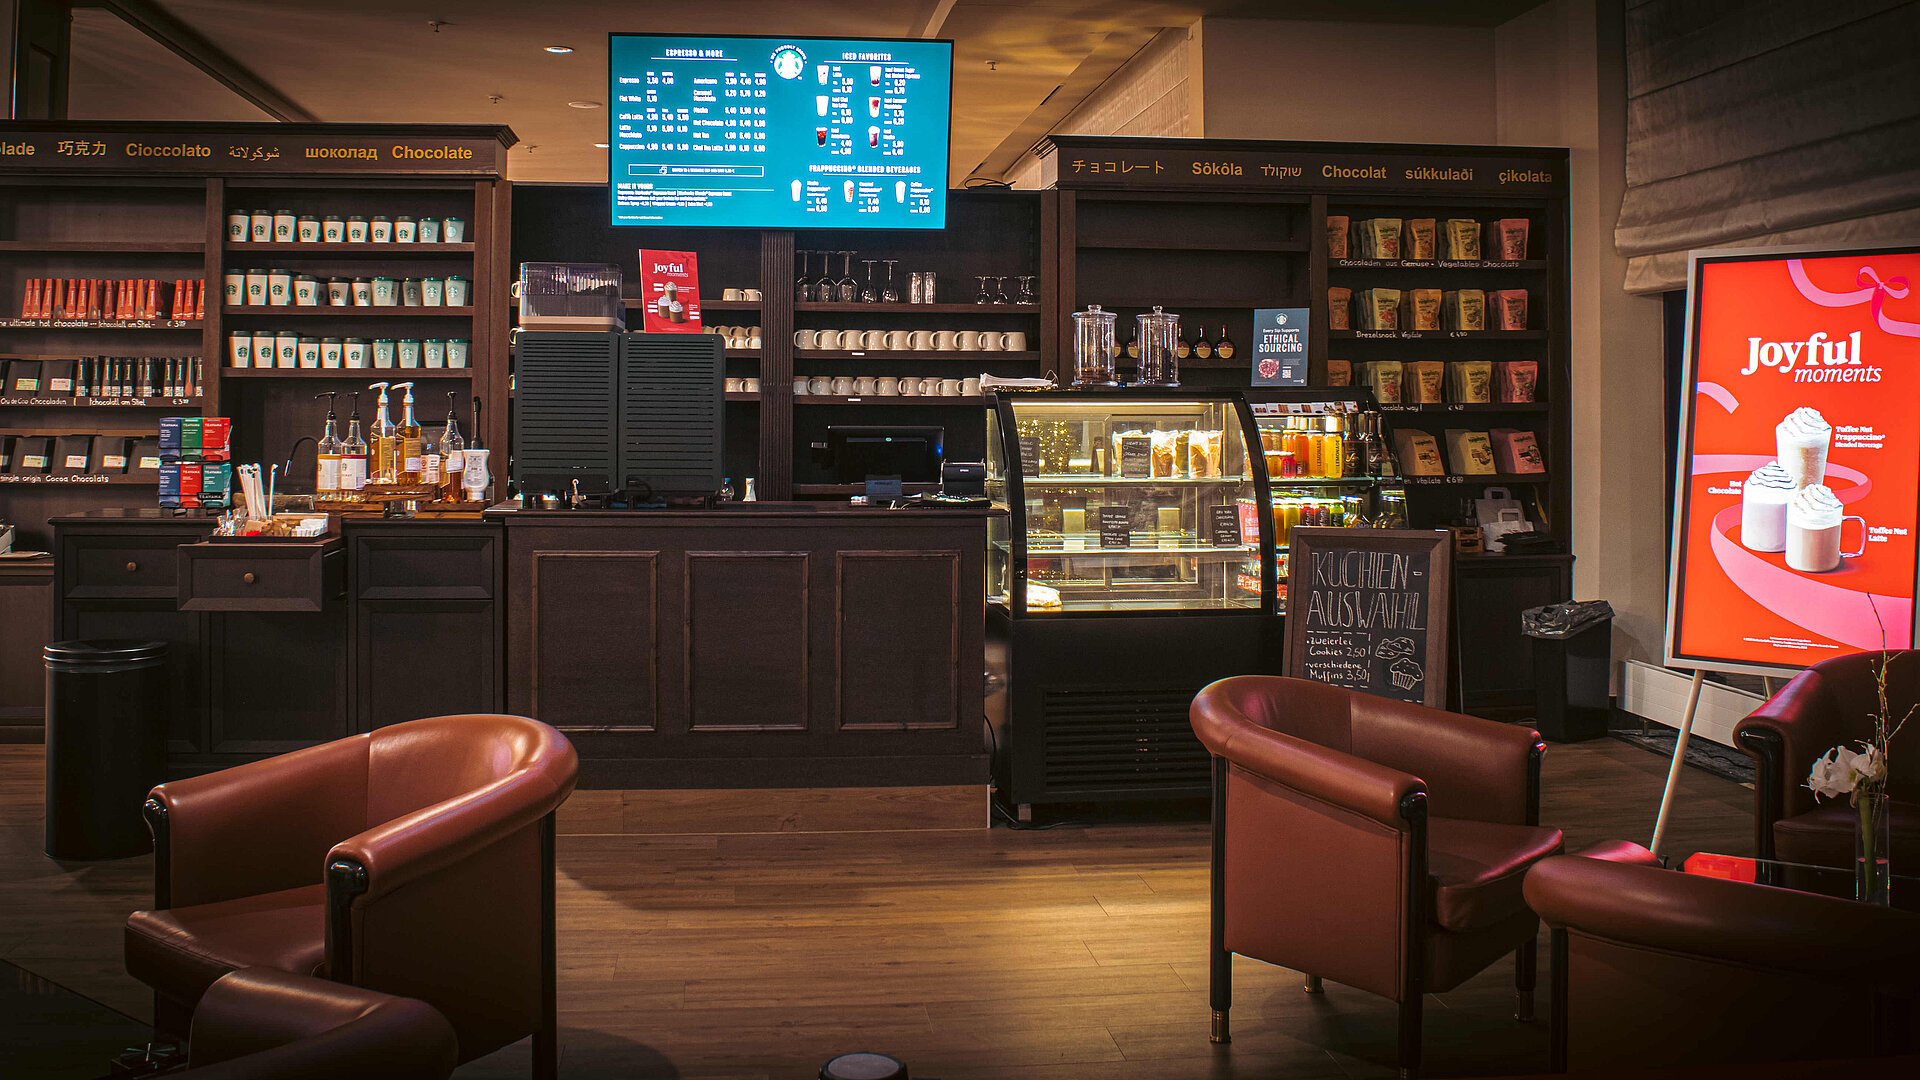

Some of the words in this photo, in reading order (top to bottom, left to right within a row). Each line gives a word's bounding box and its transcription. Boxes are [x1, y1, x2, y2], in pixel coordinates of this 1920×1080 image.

[665, 48, 697, 57] ESPRESSO
[705, 49, 723, 58] MORE
[842, 52, 857, 61] ICED
[858, 52, 892, 62] FAVORITES
[0, 141, 35, 156] lade
[57, 140, 107, 156] 巧克力
[125, 143, 212, 158] Cioccolato
[228, 146, 280, 161] شوكولاتة
[391, 145, 473, 160] Chocolate
[305, 147, 378, 161] шоколад
[857, 165, 885, 173] BLENDED
[885, 165, 921, 174] BEVERAGES
[1072, 159, 1165, 175] チョコレート
[1191, 161, 1243, 176] Sôkôla
[1260, 163, 1302, 180] שוקולד
[1322, 164, 1387, 179] Chocolat
[1405, 166, 1474, 181] súkkulaði
[1498, 169, 1553, 185] çikolata
[617, 182, 632, 190] MAKE
[653, 263, 684, 274] Joyful
[1339, 259, 1381, 267] Chocoladen
[39, 319, 50, 327] hot
[54, 319, 89, 328] chocolate
[1263, 333, 1299, 344] ETHICAL
[1356, 330, 1398, 338] Brezelsnack
[1258, 342, 1303, 353] SOURCING
[1740, 330, 1863, 377] Joyful
[1794, 364, 1883, 383] moments
[1835, 425, 1859, 433] Toffee
[1857, 442, 1883, 450] Beverage
[45, 474, 69, 483] Cocoa
[71, 473, 110, 483] Chocolats
[1729, 480, 1742, 488] Hot
[1707, 486, 1742, 495] Chocolate
[1868, 526, 1893, 535] Toffee
[1893, 527, 1908, 536] Nut
[1868, 534, 1888, 542] Latte
[1306, 590, 1426, 631] AUSWAHL
[1310, 636, 1353, 647] zweierlei
[1309, 646, 1343, 657] Cookies
[1346, 647, 1366, 658] 2,50
[1308, 659, 1363, 670] verschiedene
[1309, 669, 1343, 683] Muffins
[1346, 669, 1367, 683] 3,50
